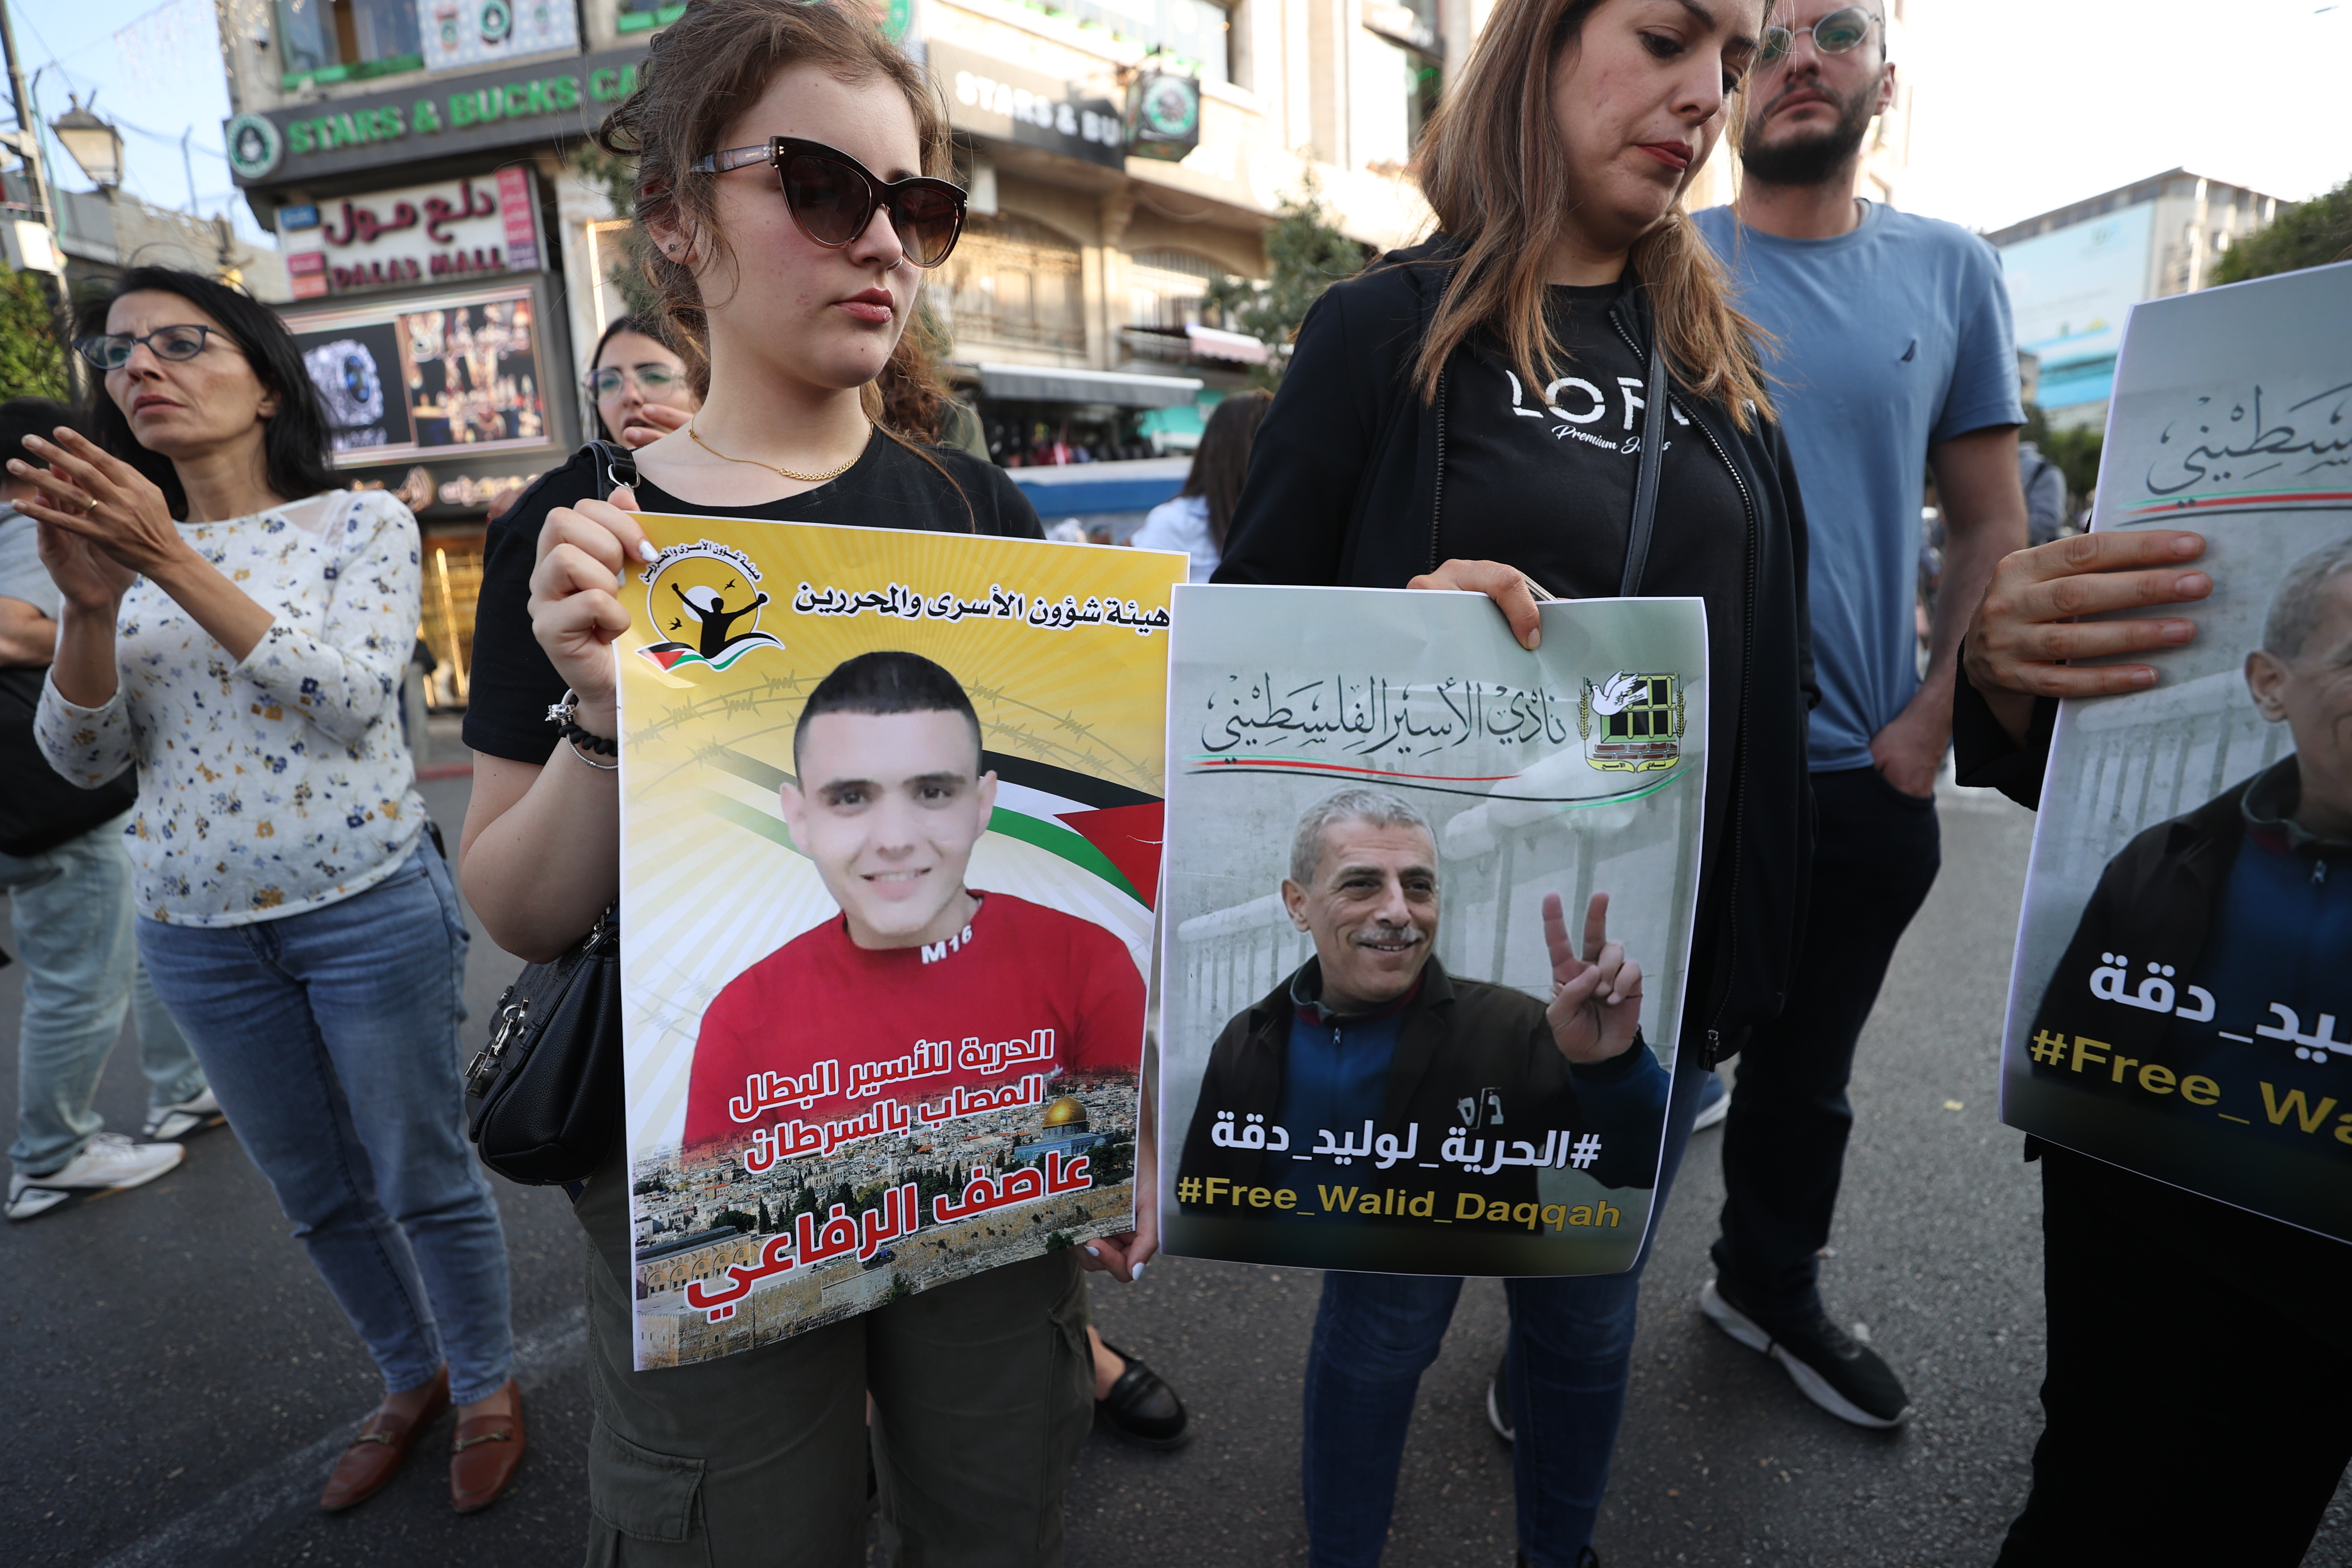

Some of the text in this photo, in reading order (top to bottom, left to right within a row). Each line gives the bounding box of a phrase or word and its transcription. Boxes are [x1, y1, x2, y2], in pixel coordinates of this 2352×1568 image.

[288, 106, 401, 153] STARS
[412, 99, 437, 132] &
[448, 75, 577, 128] BUCKS
[589, 64, 640, 101] CA
[955, 70, 1054, 129] STARS
[1056, 103, 1078, 136] &
[323, 201, 413, 245] مول
[424, 179, 494, 242] دلع
[430, 248, 502, 274] MALL
[1551, 425, 1618, 450] Premium
[641, 541, 760, 582] هيئة شؤون الأسرى والمحررين
[795, 584, 1170, 634] هيئة شؤون الأسرى والمحررين
[729, 1029, 1054, 1122] الحرية للأسير البطل
[744, 1074, 1043, 1174] المصاب بالسرطان
[1178, 1176, 1621, 1232] #Free_Walid_Daqqah
[685, 1150, 1092, 1324] عاصف الرفاعي
